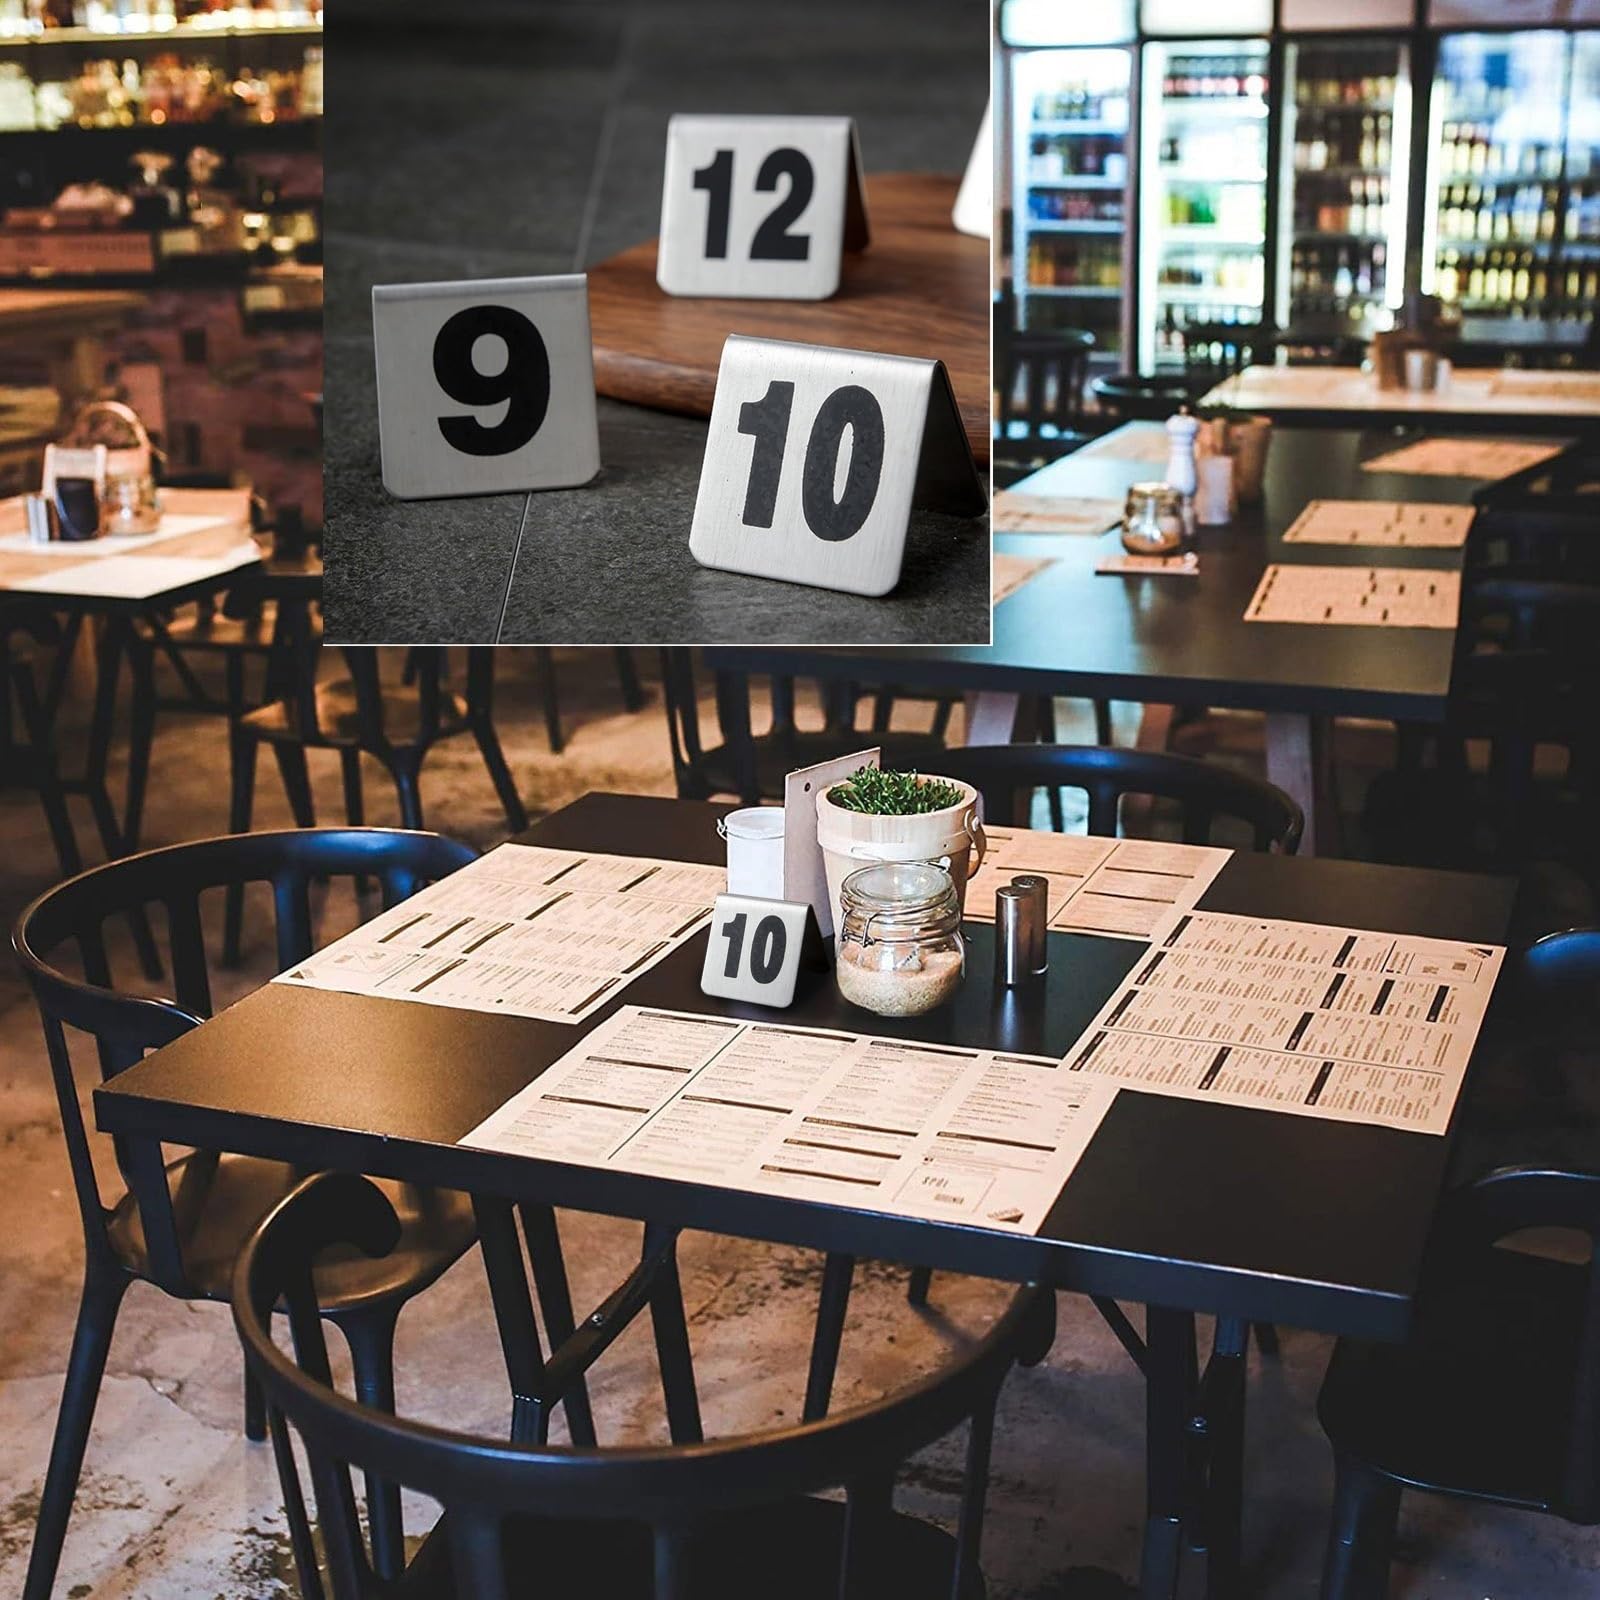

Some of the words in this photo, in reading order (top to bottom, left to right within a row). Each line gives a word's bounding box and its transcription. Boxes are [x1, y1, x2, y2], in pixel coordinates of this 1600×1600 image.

[693, 147, 815, 261] 12
[432, 305, 550, 457] 9
[737, 381, 885, 542] 10
[721, 913, 787, 984] 10
